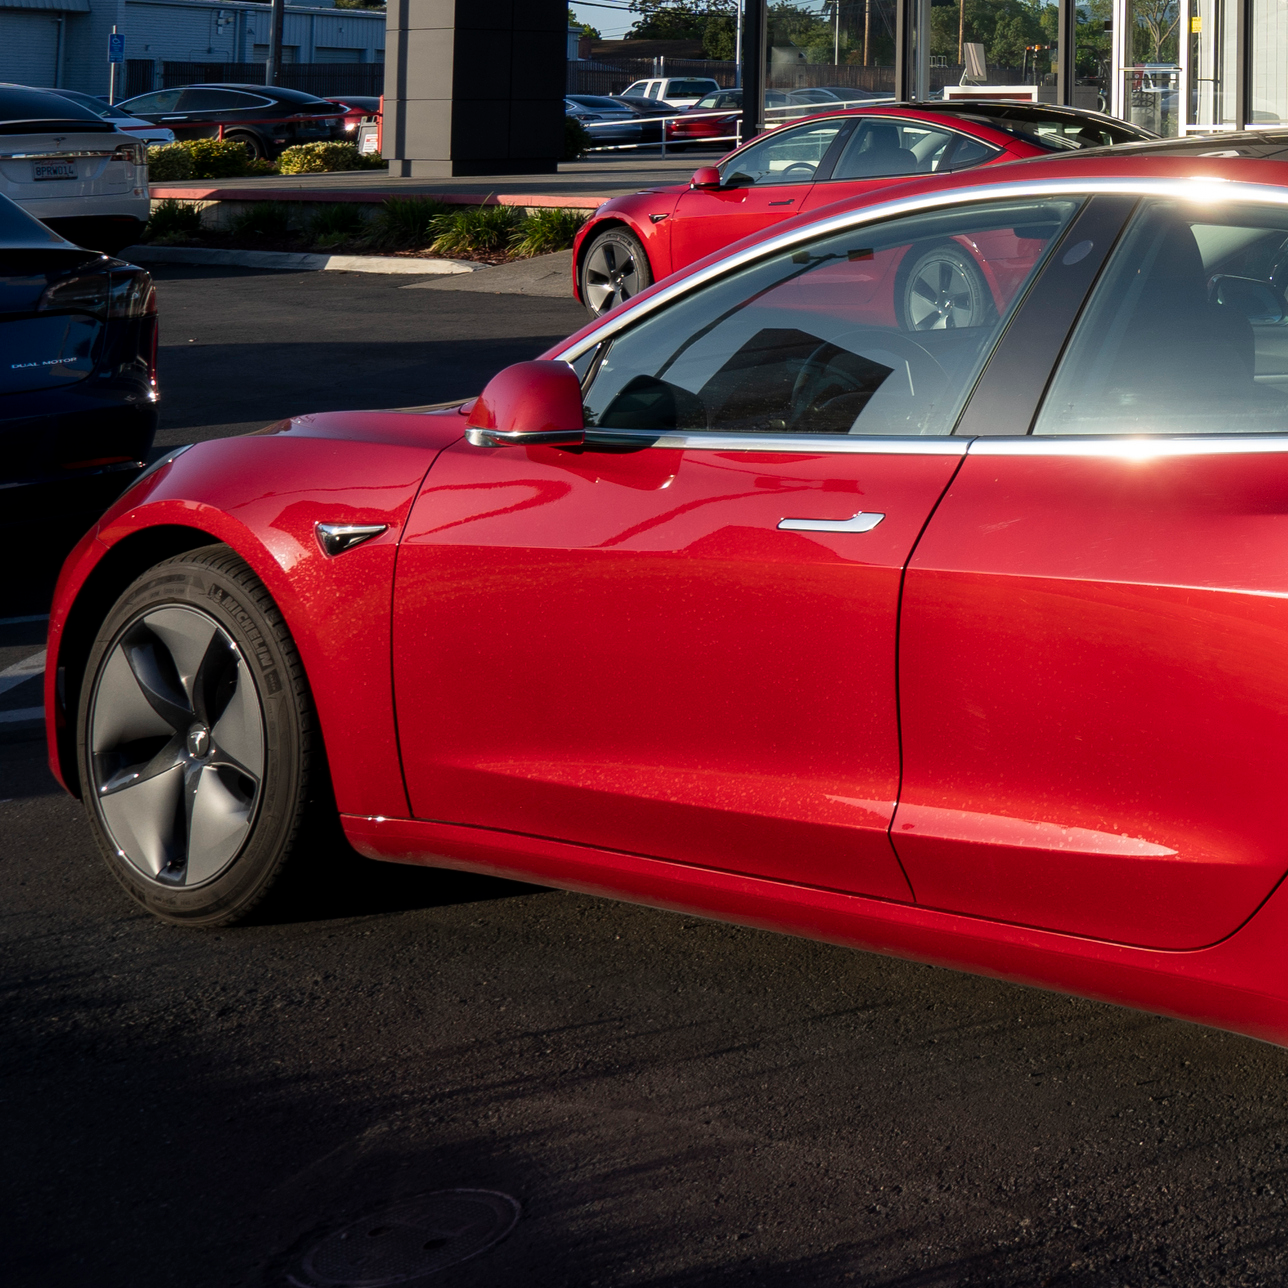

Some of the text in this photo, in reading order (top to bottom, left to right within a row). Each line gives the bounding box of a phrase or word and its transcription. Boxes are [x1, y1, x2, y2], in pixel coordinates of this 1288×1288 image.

[35, 166, 74, 176] 8PRW014
[42, 357, 77, 366] MOTOR
[222, 598, 273, 668] MICHELIN
